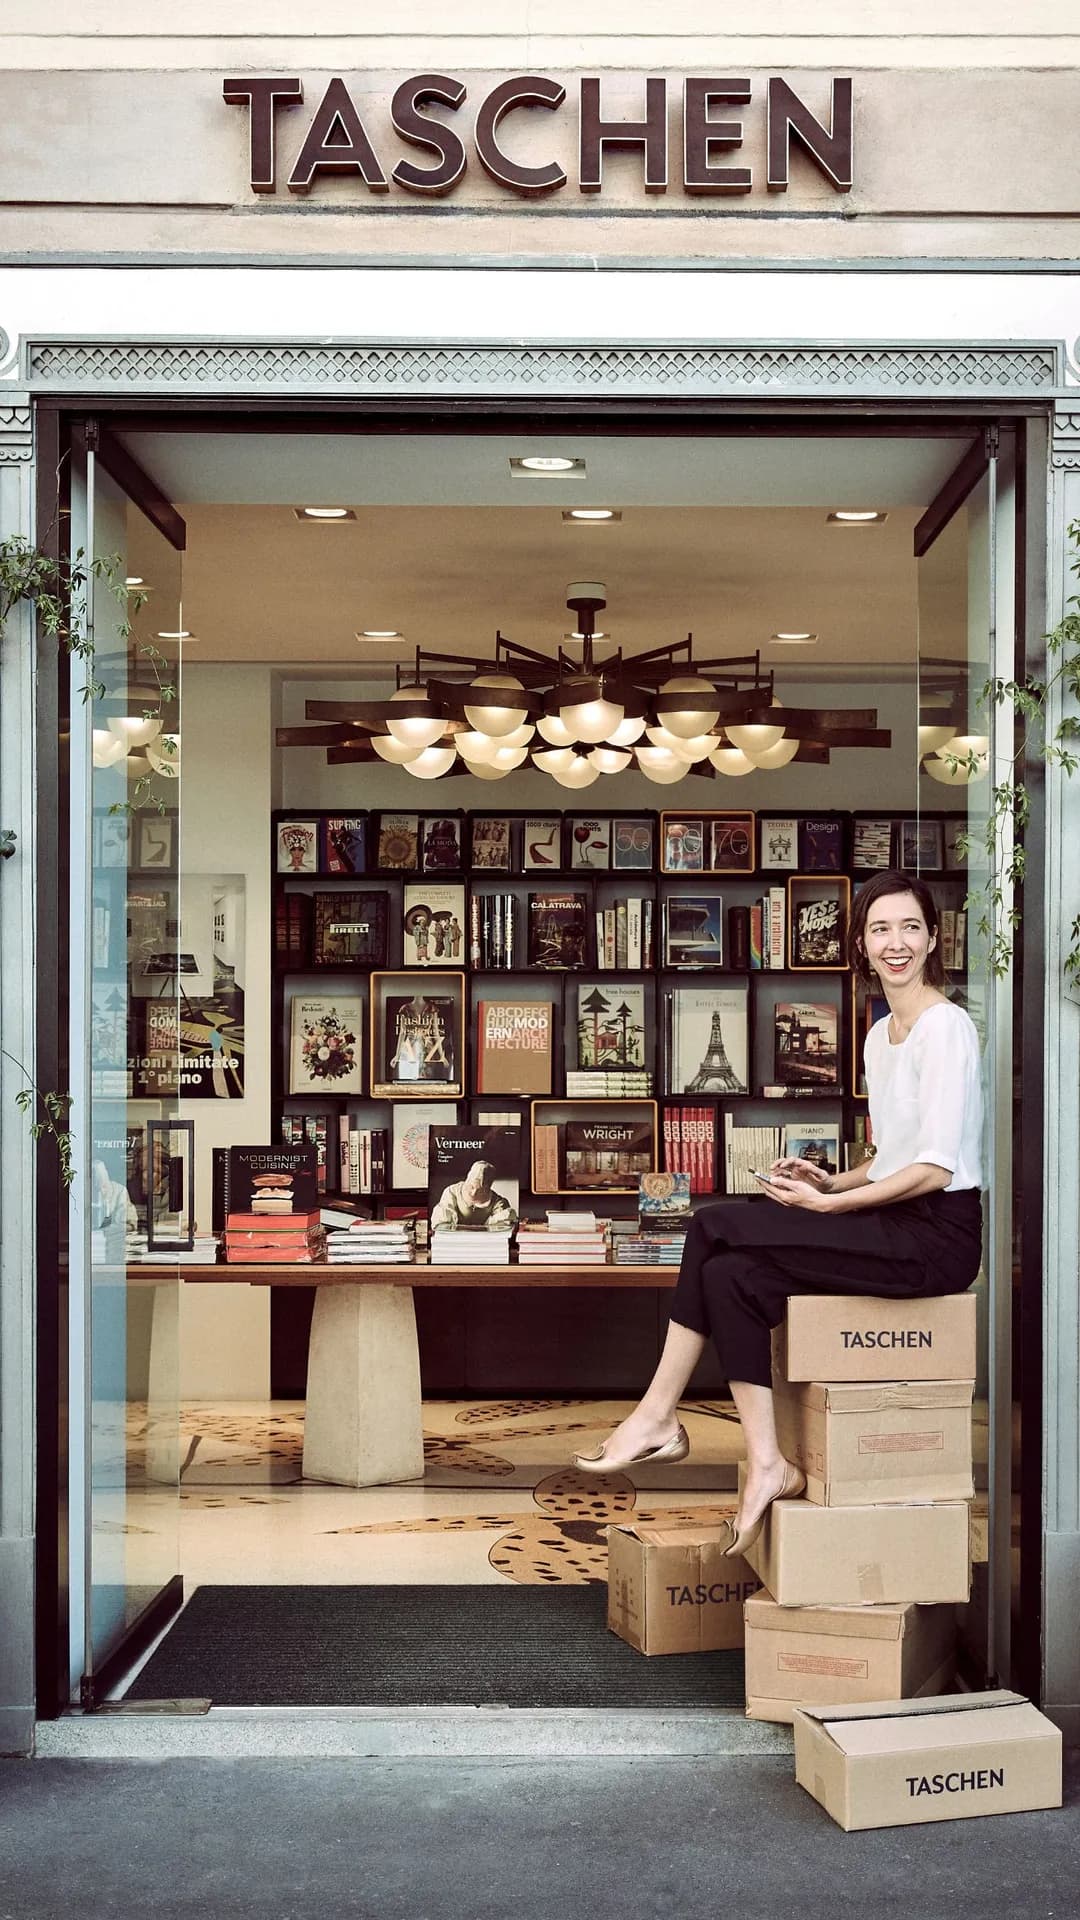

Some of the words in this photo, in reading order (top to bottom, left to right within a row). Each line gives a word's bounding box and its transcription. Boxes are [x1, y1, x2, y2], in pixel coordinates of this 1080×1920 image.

[222, 74, 853, 194] TASCHEN
[806, 822, 839, 833] Design
[799, 900, 829, 923] YES
[330, 923, 370, 934] PIRELLI
[128, 1055, 166, 1068] zioni
[158, 1074, 202, 1086] piano
[583, 1129, 634, 1140] WRIGHT
[801, 1127, 825, 1135] PIANO
[435, 1137, 485, 1149] Vermeer
[250, 1161, 296, 1169] CUISINE
[840, 1331, 932, 1349] TASCHEN
[905, 1767, 1004, 1797] TASCHEN
